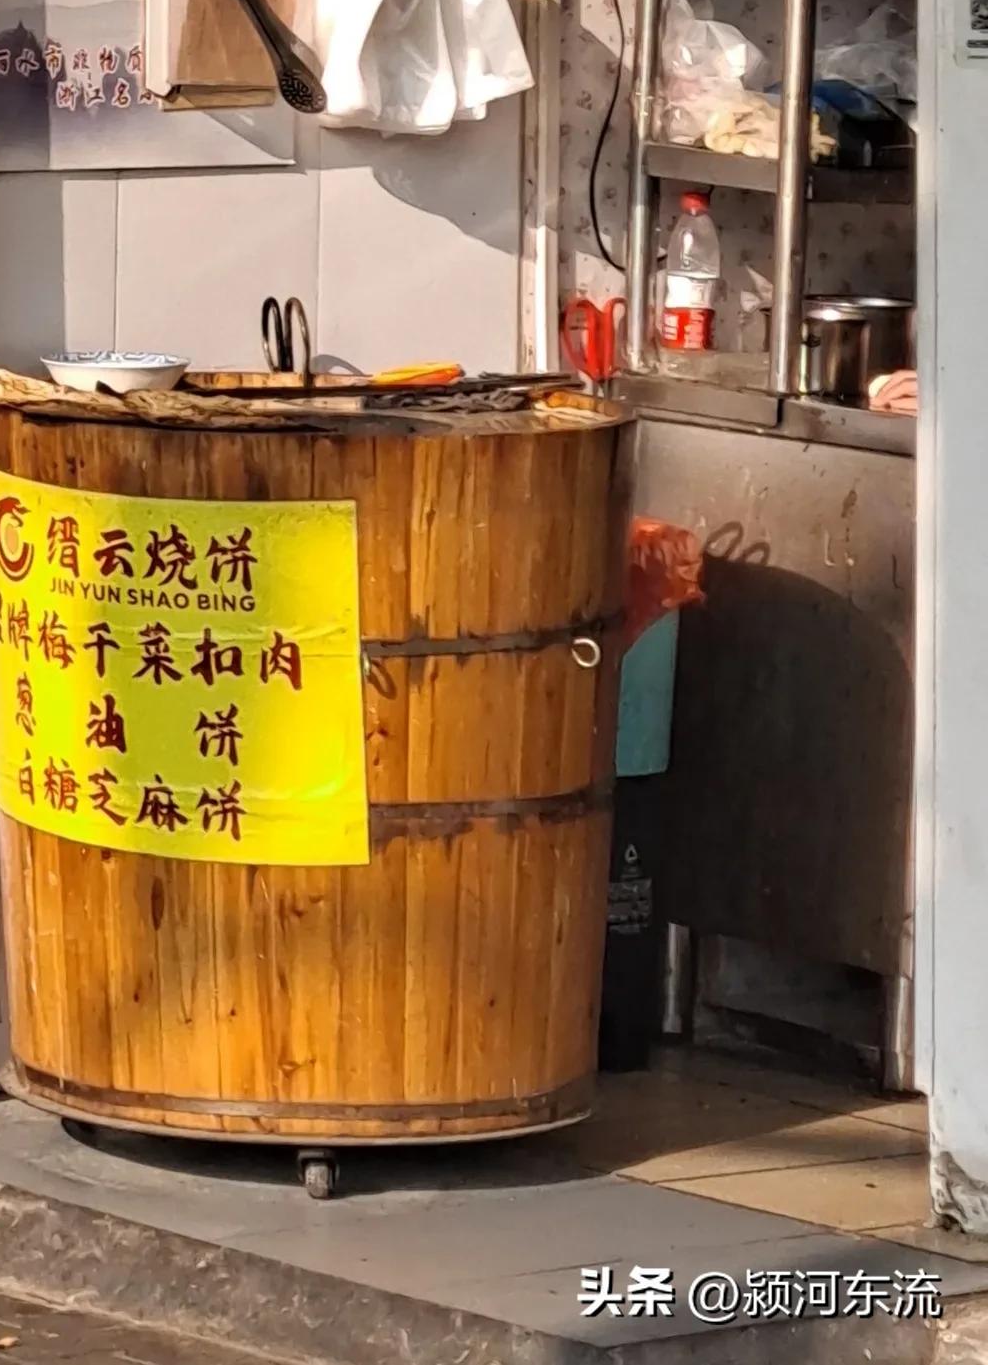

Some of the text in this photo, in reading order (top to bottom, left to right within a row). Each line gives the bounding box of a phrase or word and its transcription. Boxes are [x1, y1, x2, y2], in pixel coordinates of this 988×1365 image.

[46, 515, 259, 592] 缙云烧饼
[50, 576, 256, 612] JIN YUN SHAO BING
[16, 748, 248, 842] 白糖芝麻饼
